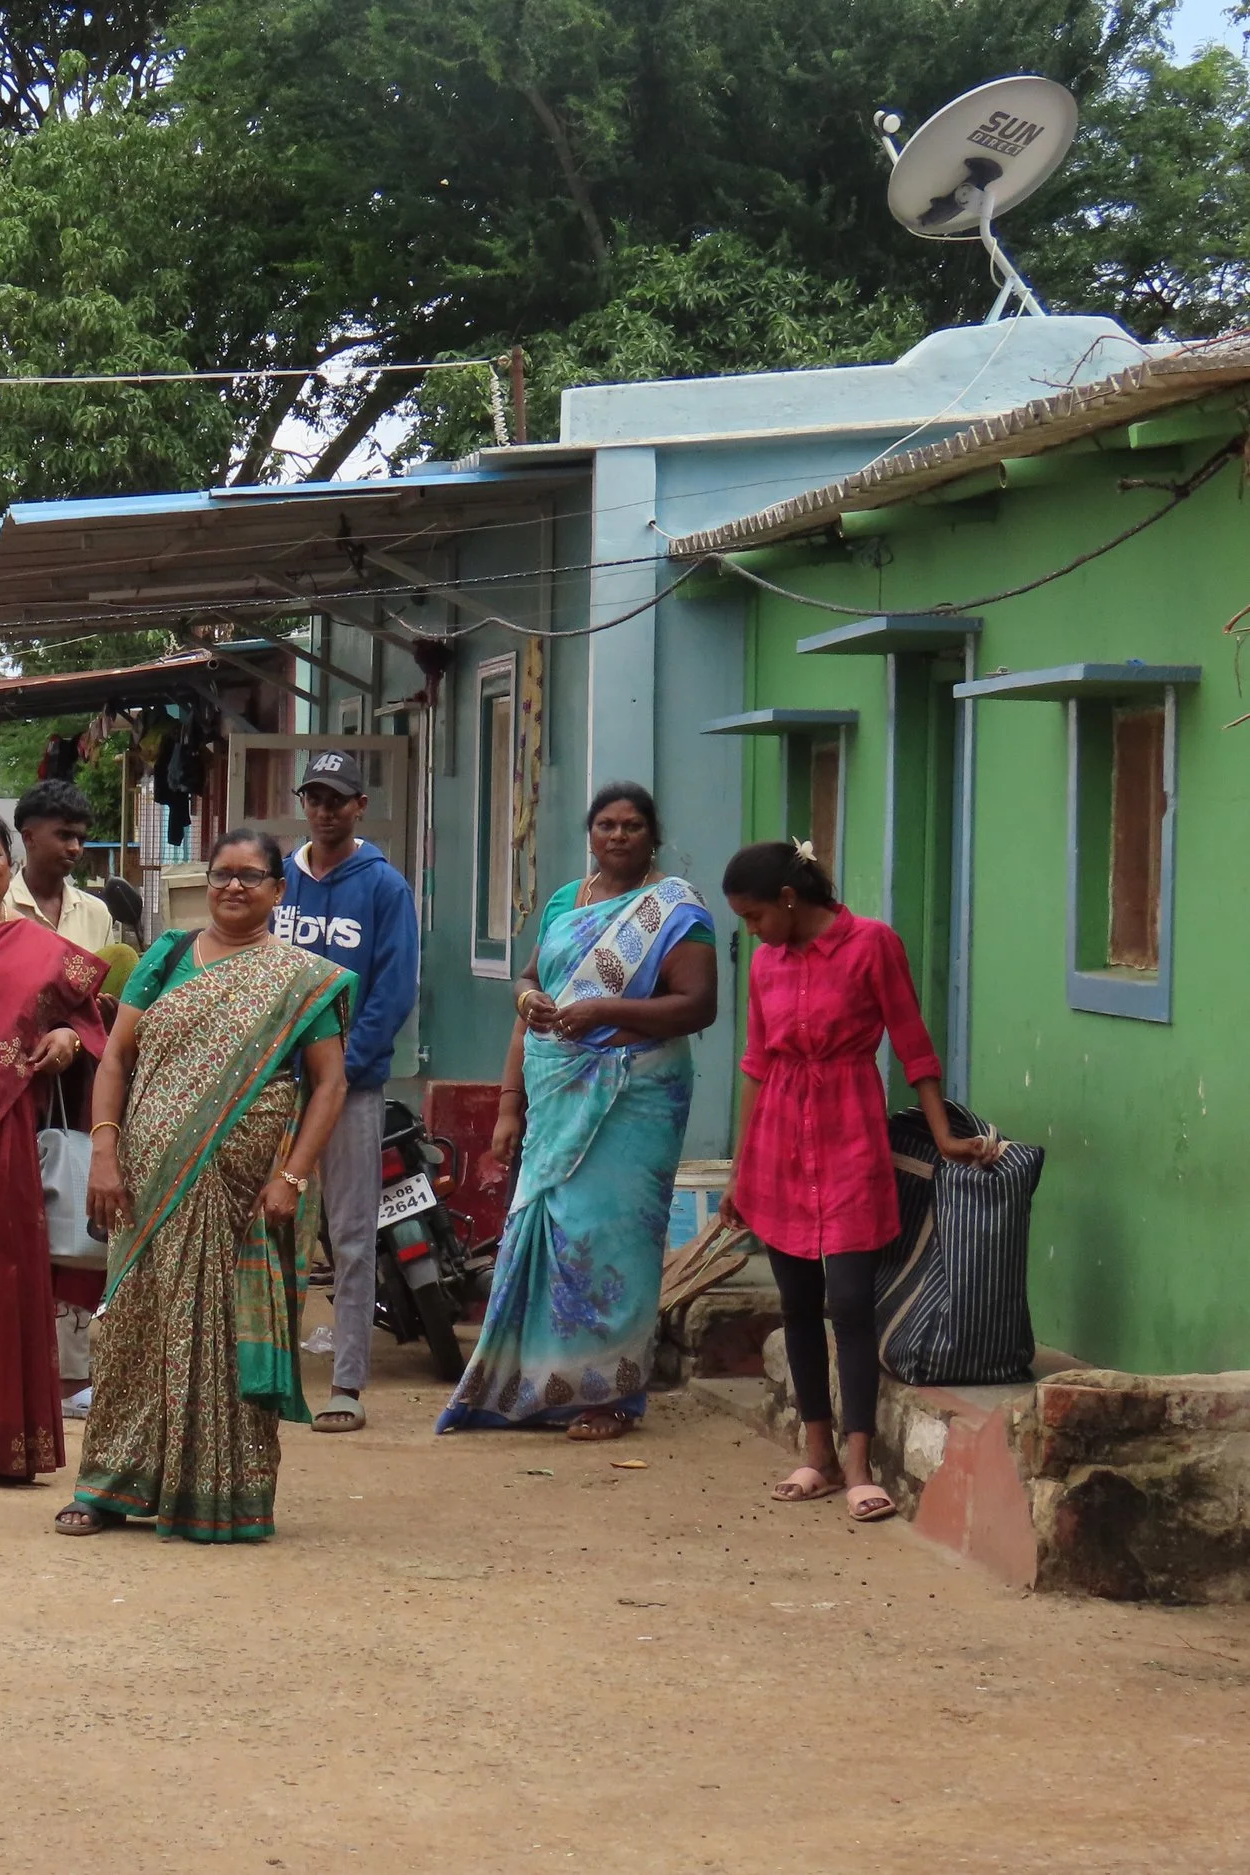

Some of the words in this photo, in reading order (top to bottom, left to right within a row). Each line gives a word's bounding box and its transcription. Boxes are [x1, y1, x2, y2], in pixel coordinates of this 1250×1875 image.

[979, 111, 1044, 146] SUN
[970, 131, 1023, 155] DIRECT
[312, 754, 343, 772] 46
[272, 905, 301, 920] THE
[273, 916, 362, 948] BOYS
[380, 1185, 414, 1206] A-08
